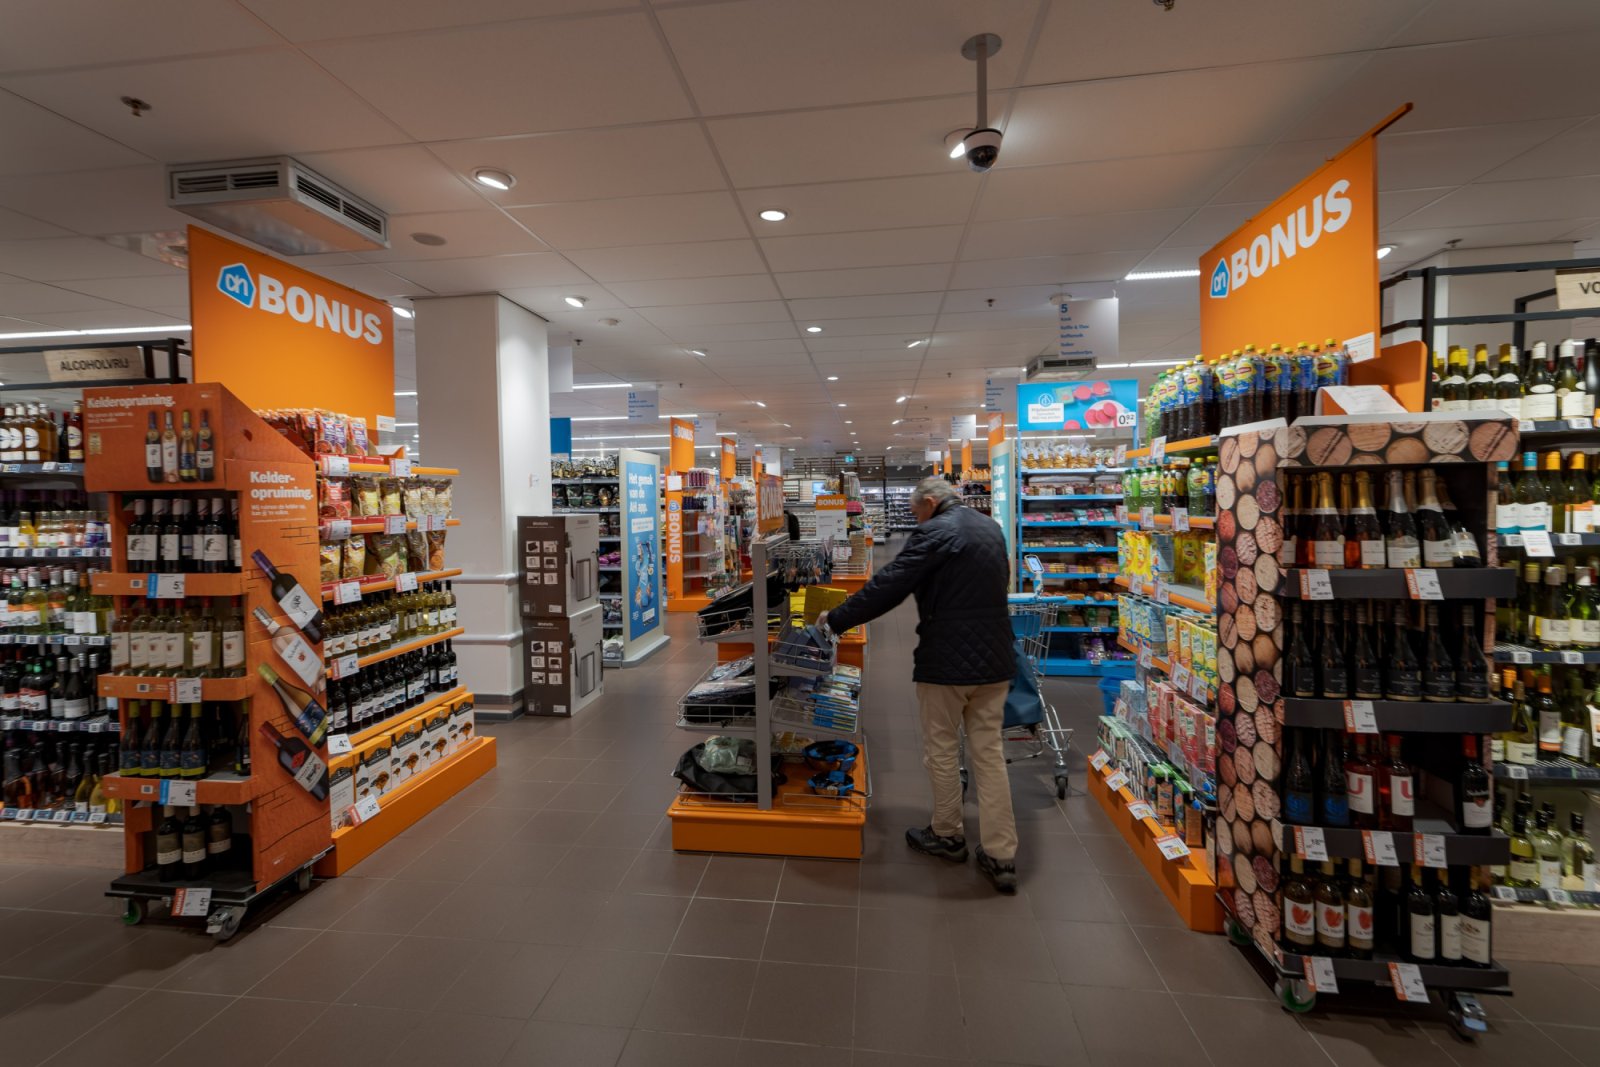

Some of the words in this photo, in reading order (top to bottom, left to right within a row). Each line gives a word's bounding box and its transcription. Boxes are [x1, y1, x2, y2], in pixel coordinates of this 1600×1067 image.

[1231, 179, 1352, 291] BONUS
[259, 274, 383, 345] BONUS
[1061, 303, 1068, 314] 5
[61, 358, 129, 371] ALCOHOLVRIJ
[87, 394, 176, 408] Kelderopruiming.
[1119, 415, 1134, 424] 0.92
[250, 471, 295, 483] Kelder-
[251, 486, 314, 500] opruiming.
[669, 513, 681, 564] BONUS
